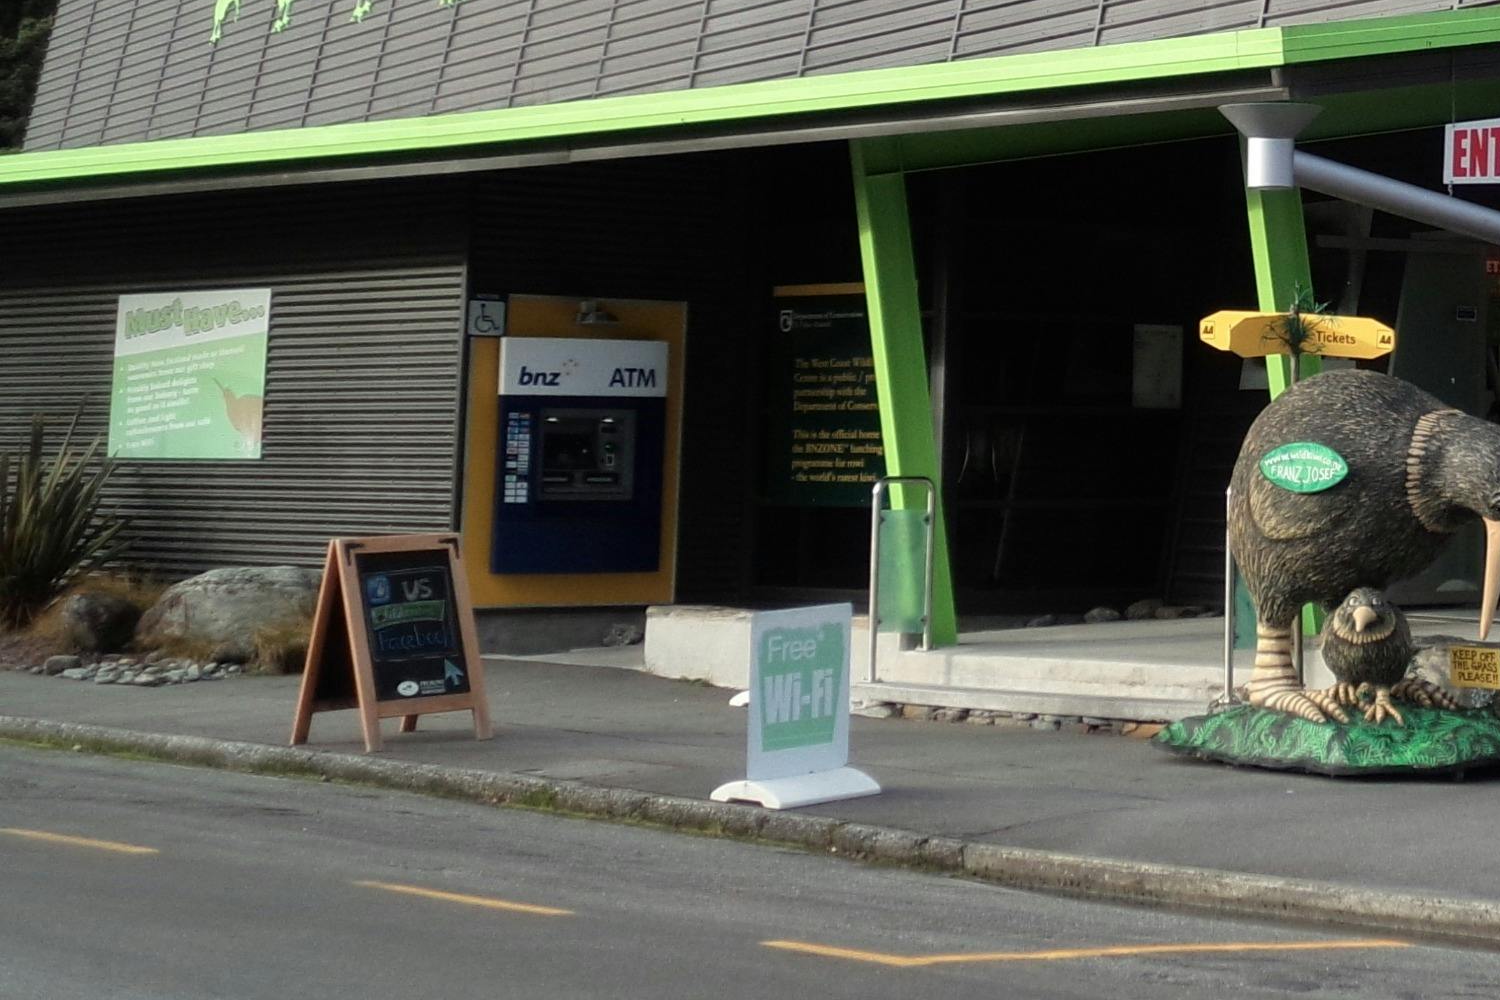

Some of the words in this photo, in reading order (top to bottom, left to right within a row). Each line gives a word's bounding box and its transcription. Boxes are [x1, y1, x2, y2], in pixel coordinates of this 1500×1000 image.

[124, 298, 184, 340] Must
[1202, 326, 1214, 334] AA
[1316, 330, 1356, 344] Tickets
[1379, 335, 1392, 344] AA
[518, 366, 560, 386] bnz
[608, 368, 656, 388] ATM
[1270, 465, 1302, 482] FRANZ
[1302, 466, 1336, 484] JOSEF
[401, 577, 433, 601] US
[768, 635, 817, 663] Free
[1452, 649, 1478, 661] KEEP
[1480, 652, 1496, 662] OFF
[1452, 660, 1470, 670] THE
[1471, 661, 1498, 672] GRASS
[1458, 672, 1498, 685] PLEASE!!
[764, 668, 833, 724] Wi-Fi
